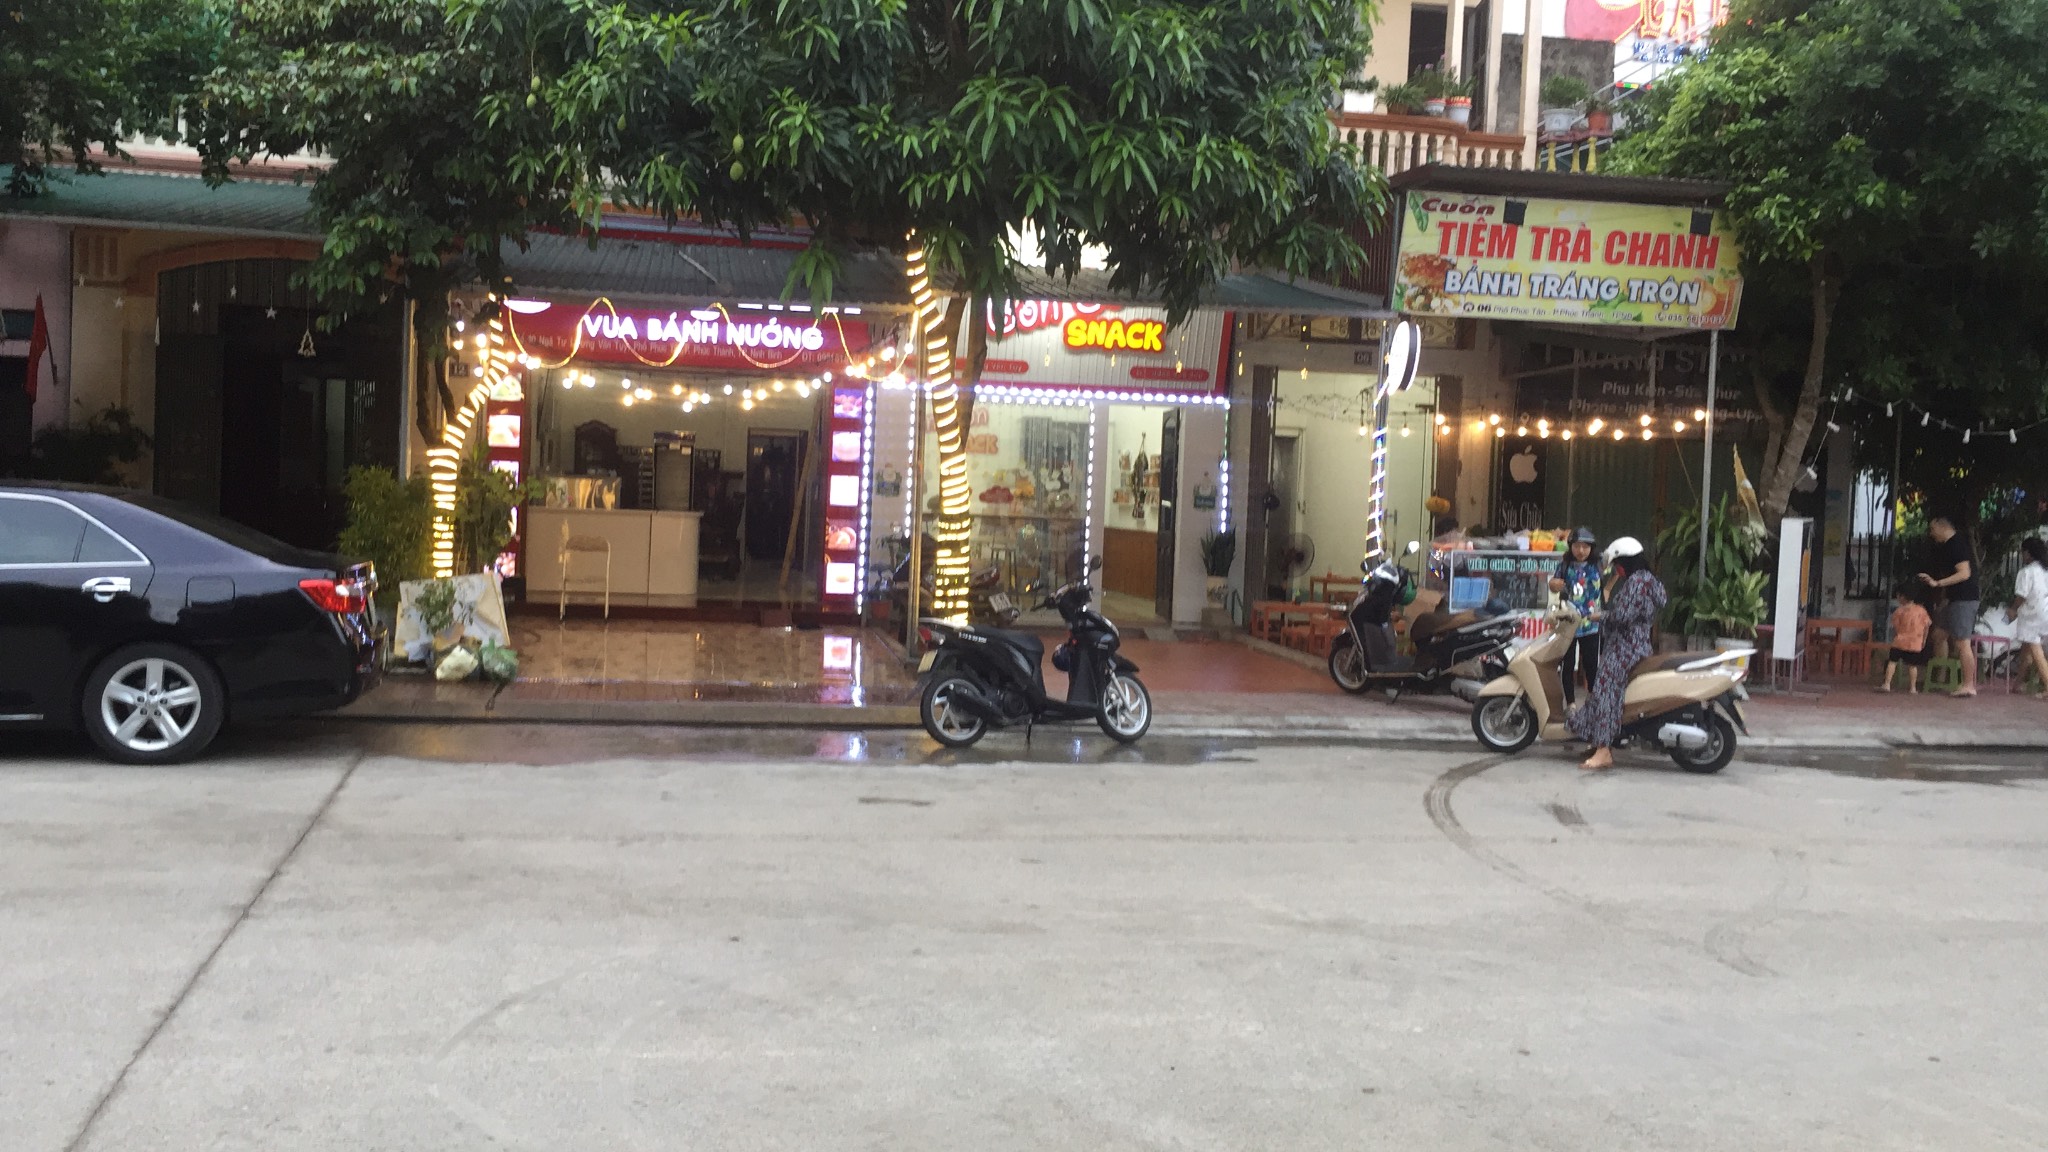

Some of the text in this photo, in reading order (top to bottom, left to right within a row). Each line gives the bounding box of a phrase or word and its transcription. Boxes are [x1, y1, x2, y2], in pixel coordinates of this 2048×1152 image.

[1438, 217, 1720, 270] TIỆM TRÀ CHANH
[1443, 265, 1701, 311] BÁNH TRÁNG TRỘN
[584, 315, 638, 340] VUA
[647, 311, 719, 344] BÁNH
[1067, 318, 1163, 351] SNACK
